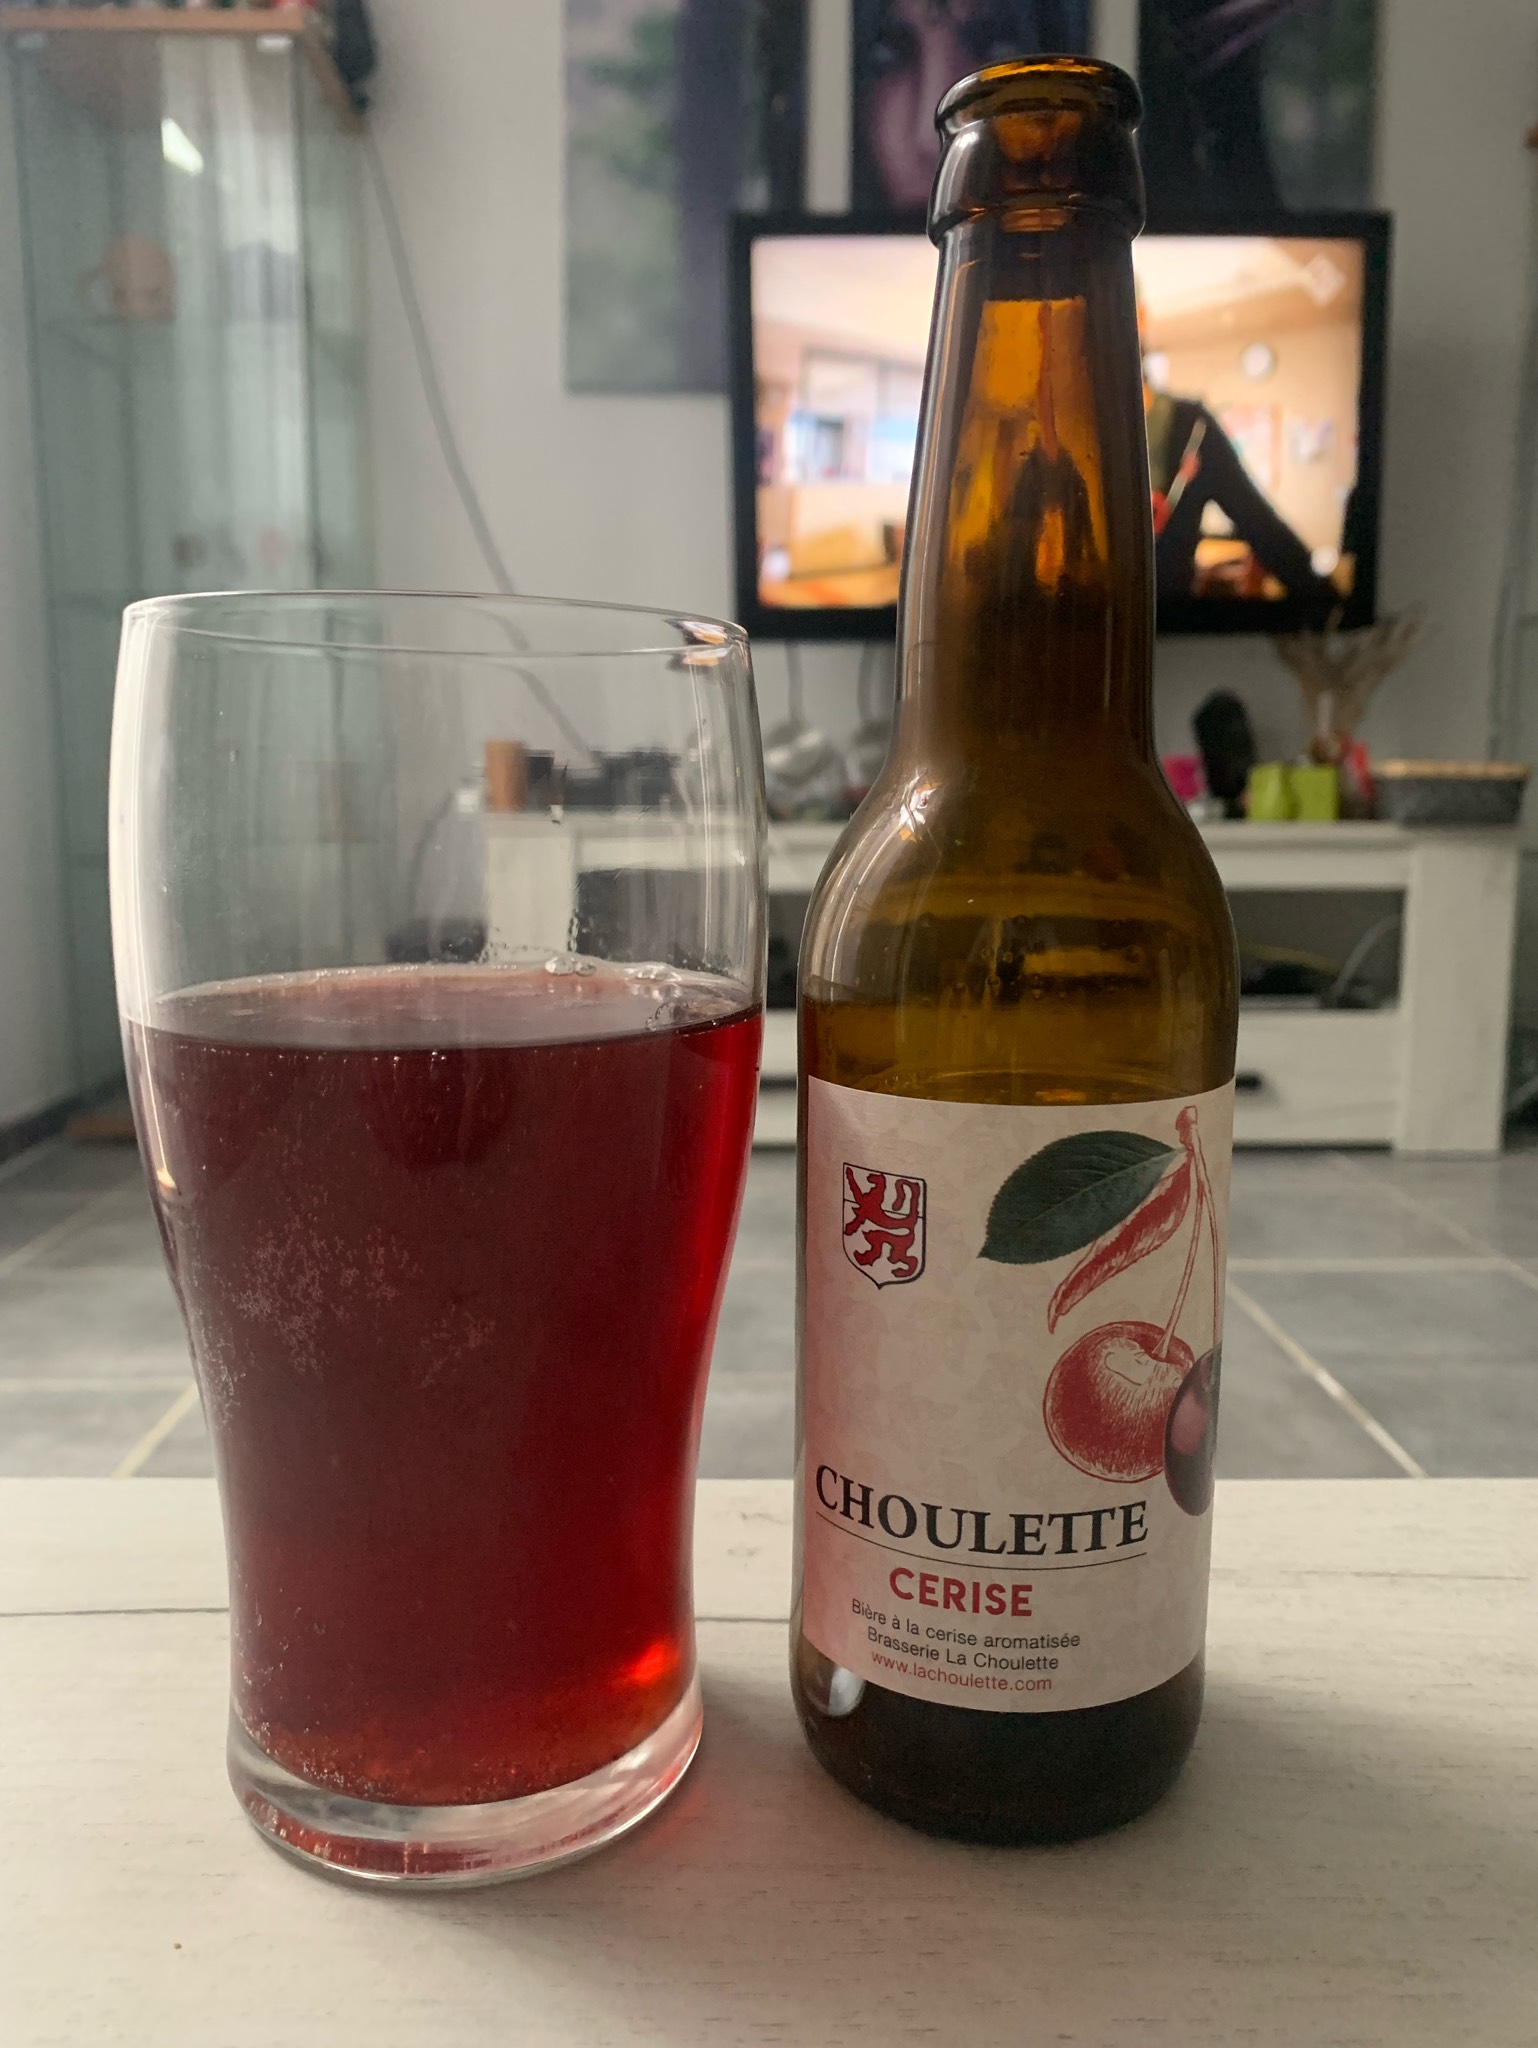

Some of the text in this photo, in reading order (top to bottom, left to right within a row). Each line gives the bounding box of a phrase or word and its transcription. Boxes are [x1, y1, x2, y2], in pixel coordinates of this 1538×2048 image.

[816, 1464, 1149, 1556] CHOULETTE
[889, 1567, 1034, 1618] CERISE
[851, 1598, 1081, 1650] Bière à la cerise aromatisée
[867, 1626, 1059, 1671] Brasserie La Choulette
[871, 1651, 1053, 1692] www.lachoulette.com
